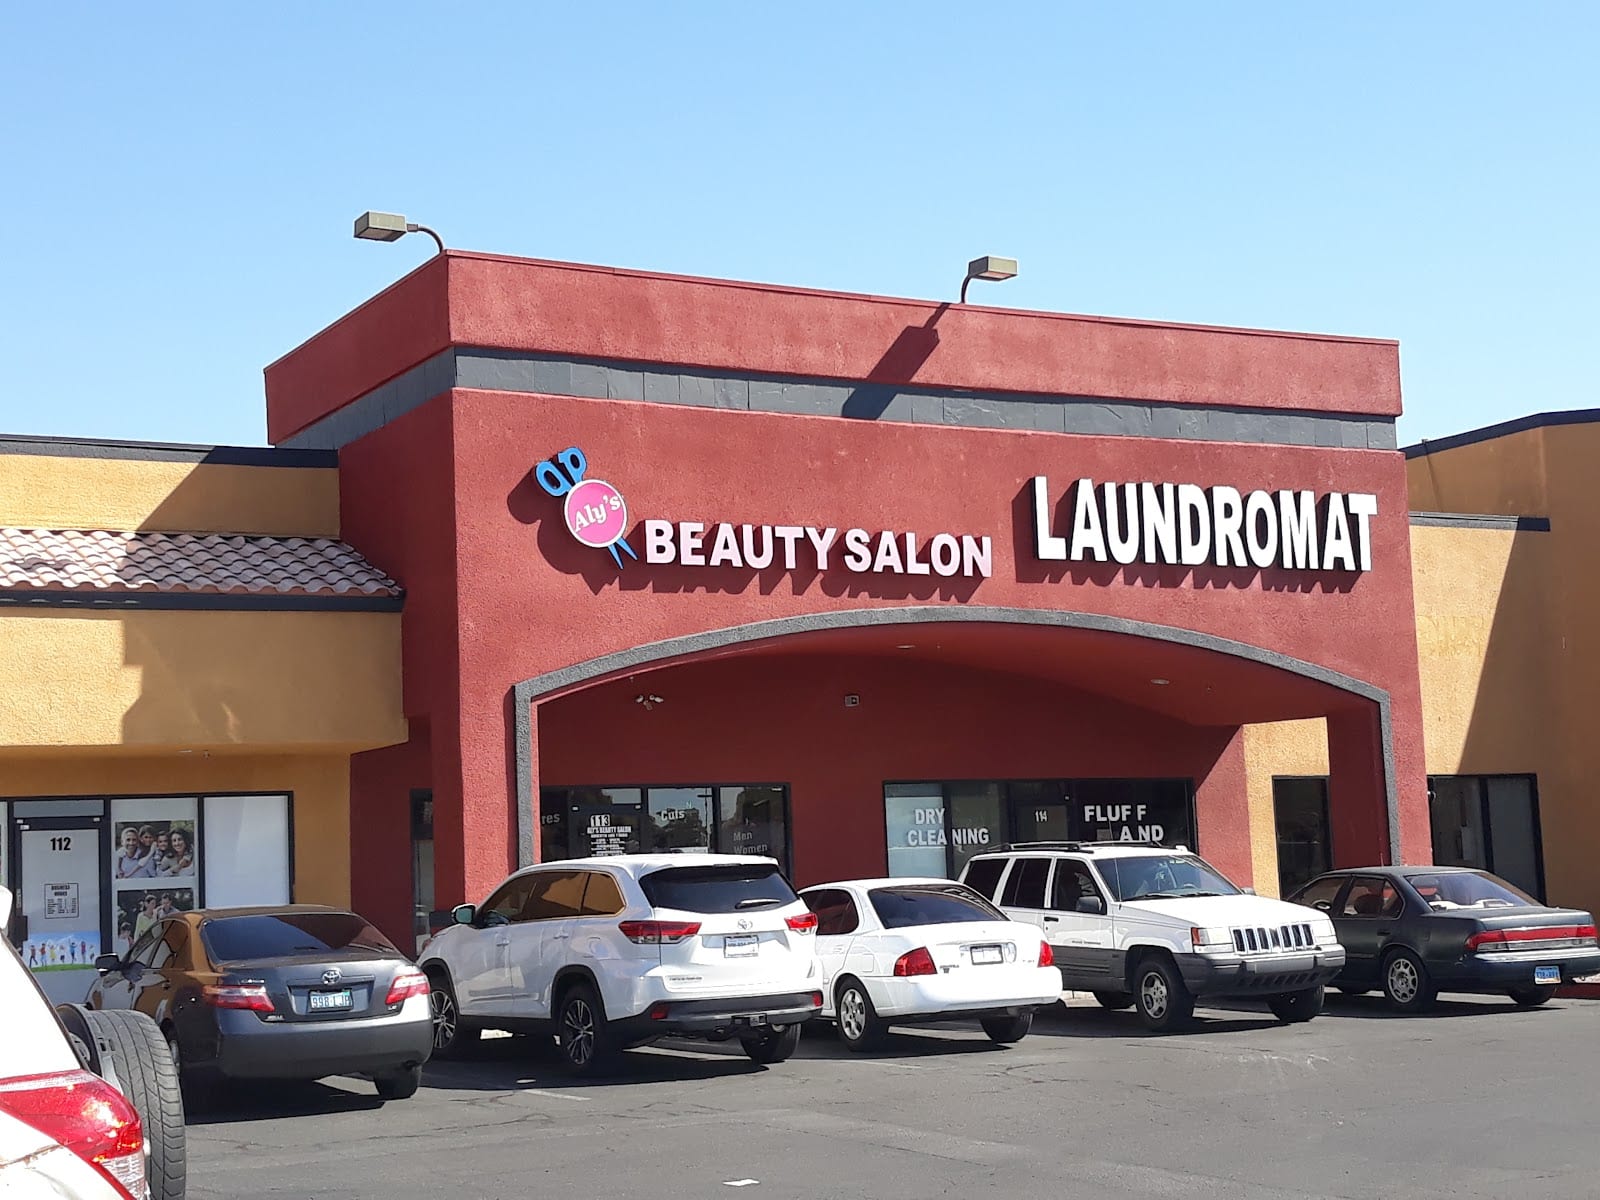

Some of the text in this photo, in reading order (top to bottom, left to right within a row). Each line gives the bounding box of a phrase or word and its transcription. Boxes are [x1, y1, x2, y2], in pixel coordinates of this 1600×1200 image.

[575, 494, 621, 533] Aly's
[1034, 476, 1378, 571] LAUNDROMAT
[644, 519, 992, 577] BEAUTY SALON
[590, 814, 610, 827] 113
[661, 810, 685, 821] Cuts
[915, 808, 945, 825] DRY
[1035, 810, 1048, 822] 114
[907, 828, 989, 846] CLEANING
[1120, 825, 1164, 841] AND
[50, 837, 71, 851] 112
[733, 844, 768, 854] Women
